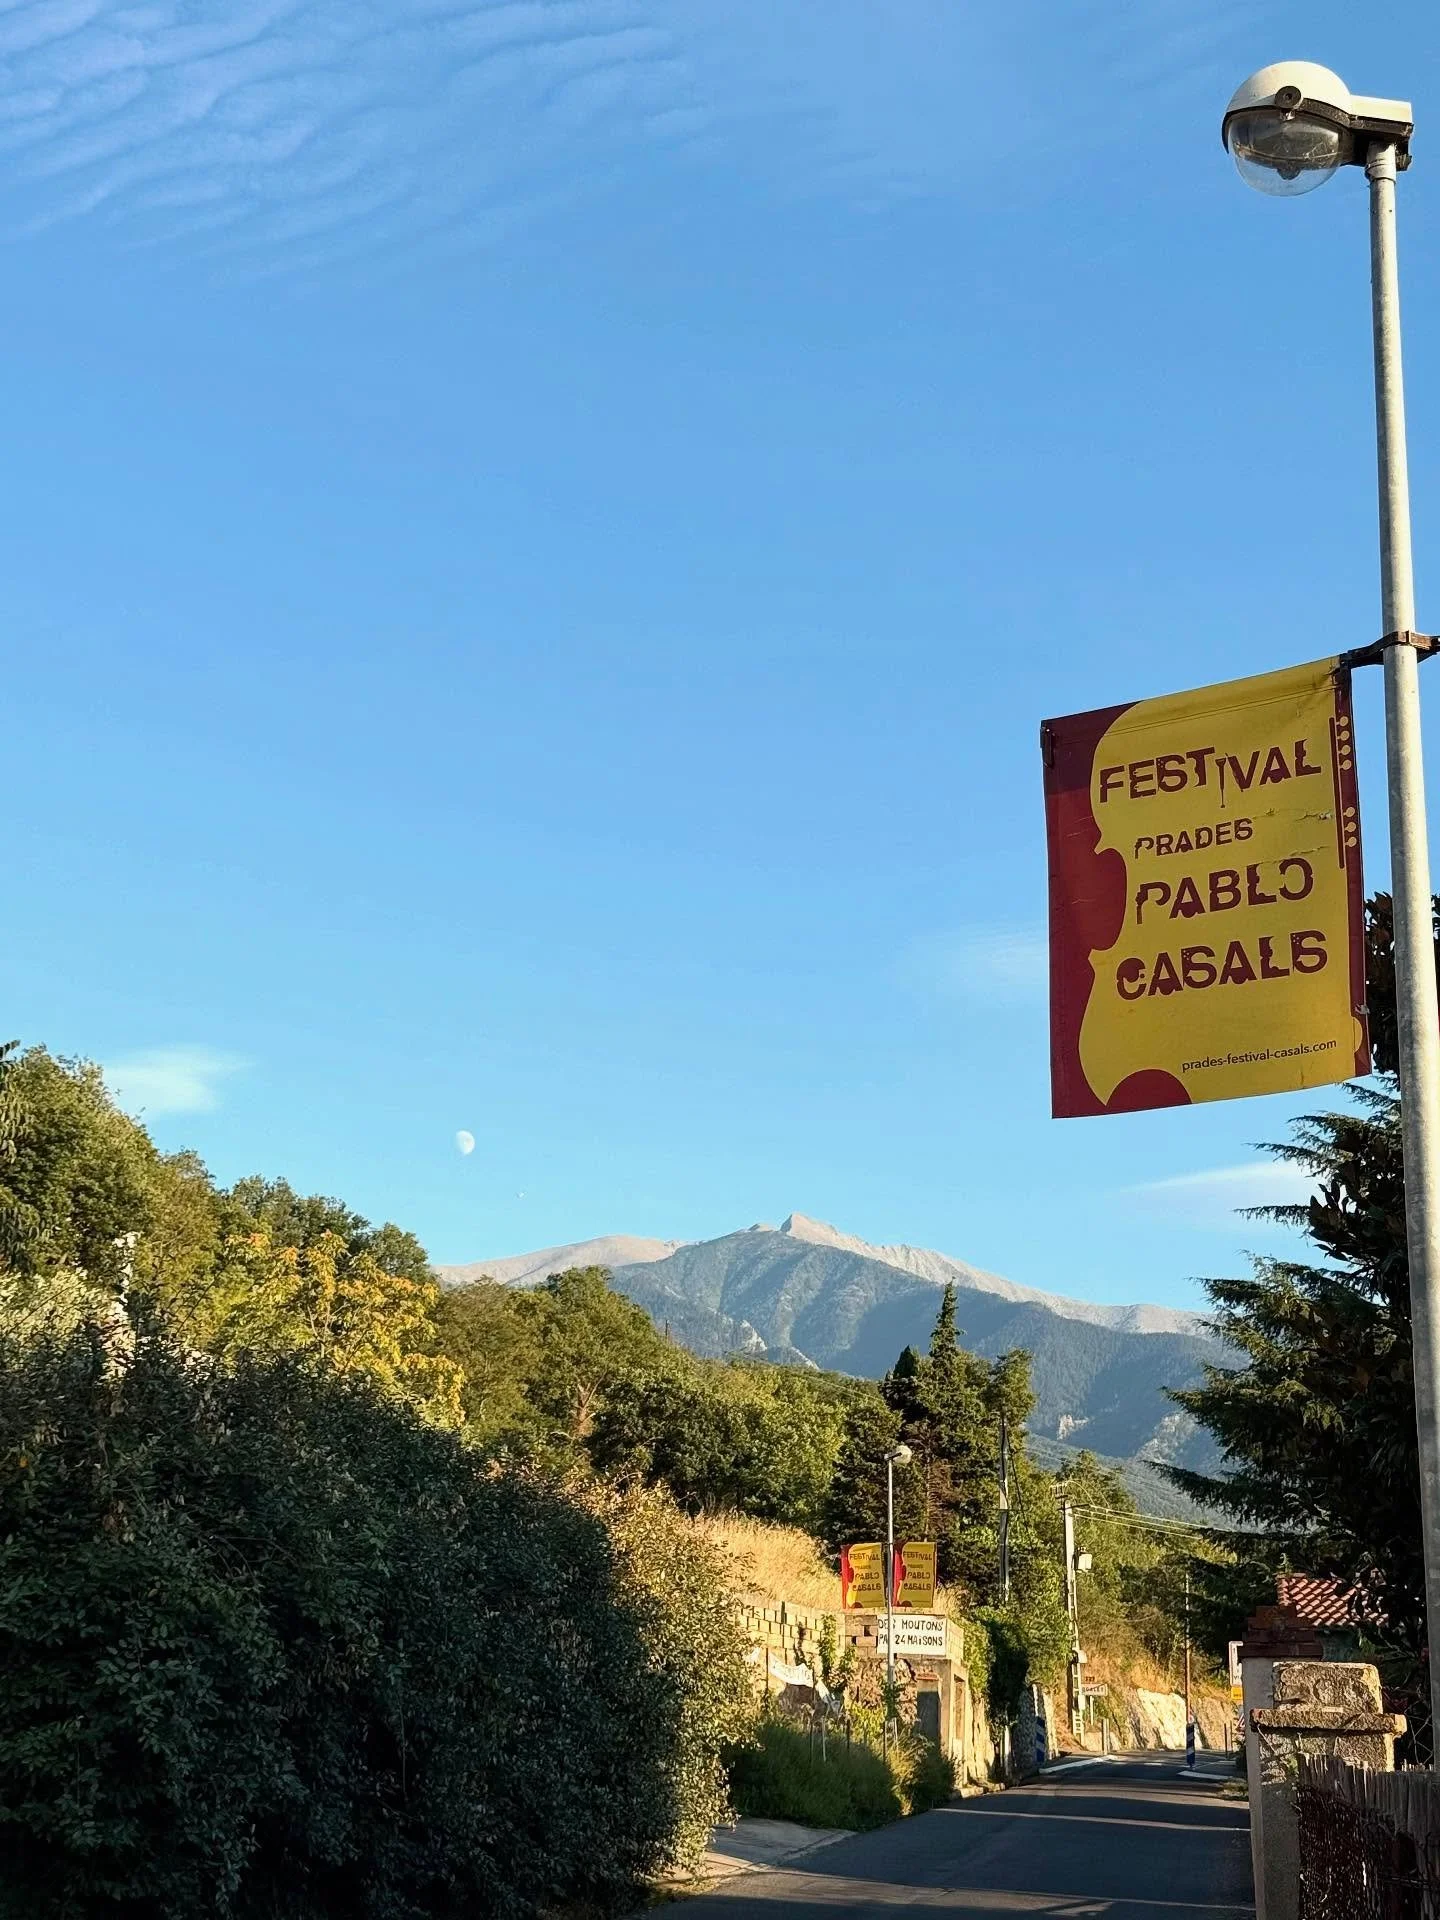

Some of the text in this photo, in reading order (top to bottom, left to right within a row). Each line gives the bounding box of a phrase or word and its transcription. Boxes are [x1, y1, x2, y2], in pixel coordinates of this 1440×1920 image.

[1099, 738, 1322, 808] FESTIVAL
[1134, 817, 1253, 859] PRADES
[1135, 857, 1314, 924] PABLO
[1116, 929, 1328, 1001] CASALS
[1181, 1039, 1337, 1073] prades-festival-casals.com
[849, 1552, 880, 1561] FESTIVAL
[903, 1551, 932, 1560] FESTIVAL
[855, 1571, 879, 1580] PABLO
[907, 1571, 930, 1579] PABLO
[852, 1582, 881, 1591] CASALS
[902, 1620, 944, 1631] MOUTONS
[895, 1634, 906, 1644] 24
